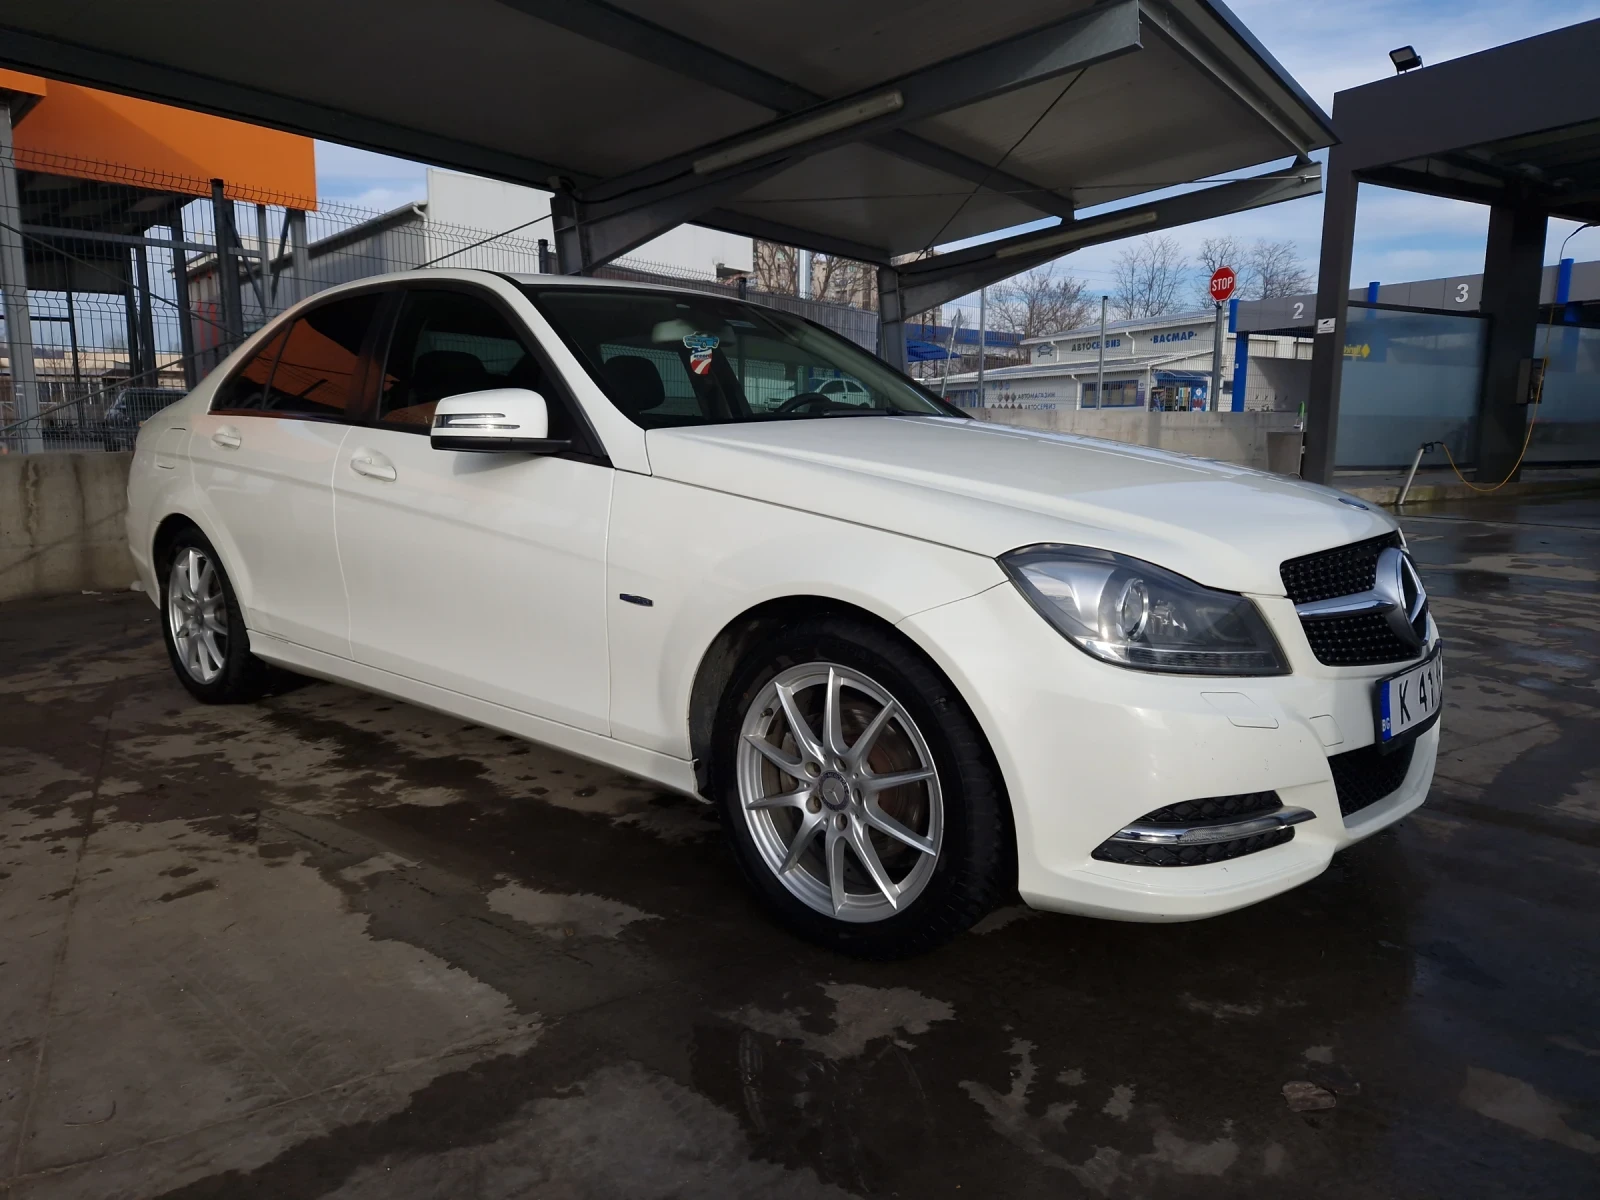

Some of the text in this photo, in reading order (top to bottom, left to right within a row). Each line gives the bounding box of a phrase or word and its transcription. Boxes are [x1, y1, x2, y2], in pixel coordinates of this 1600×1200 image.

[1212, 276, 1233, 291] STOP
[1455, 283, 1469, 303] 3
[1292, 302, 1304, 319] 2
[1071, 339, 1121, 352] АВТОСЕВИЗ
[1399, 665, 1439, 725] K 41
[1382, 717, 1390, 732] BG
